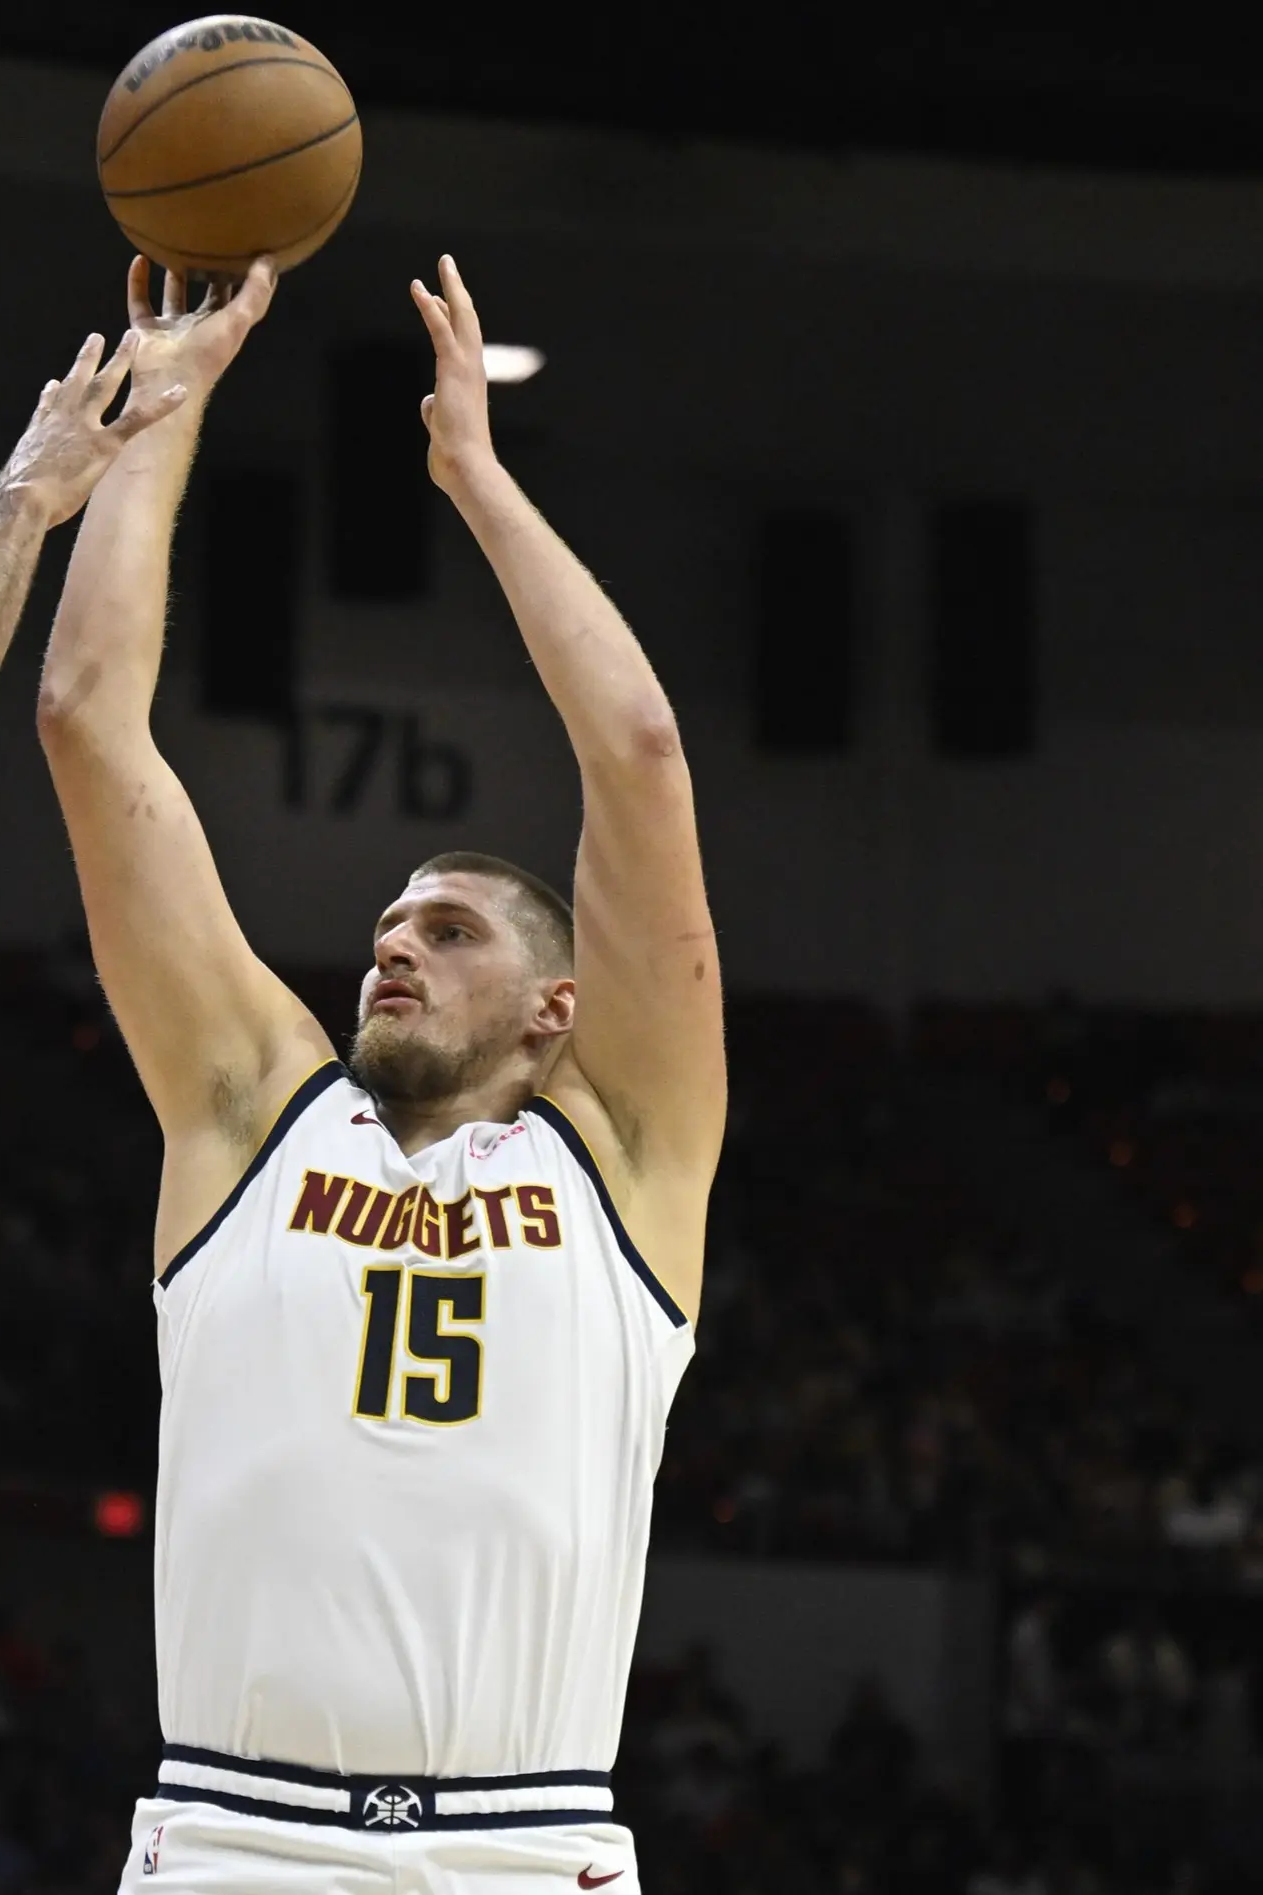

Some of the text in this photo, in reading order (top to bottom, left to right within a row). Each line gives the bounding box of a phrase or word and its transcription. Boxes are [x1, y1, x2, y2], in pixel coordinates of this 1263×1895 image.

[275, 703, 474, 820] 17b
[287, 1168, 563, 1261] NUGGETS
[351, 1265, 486, 1427] 15
